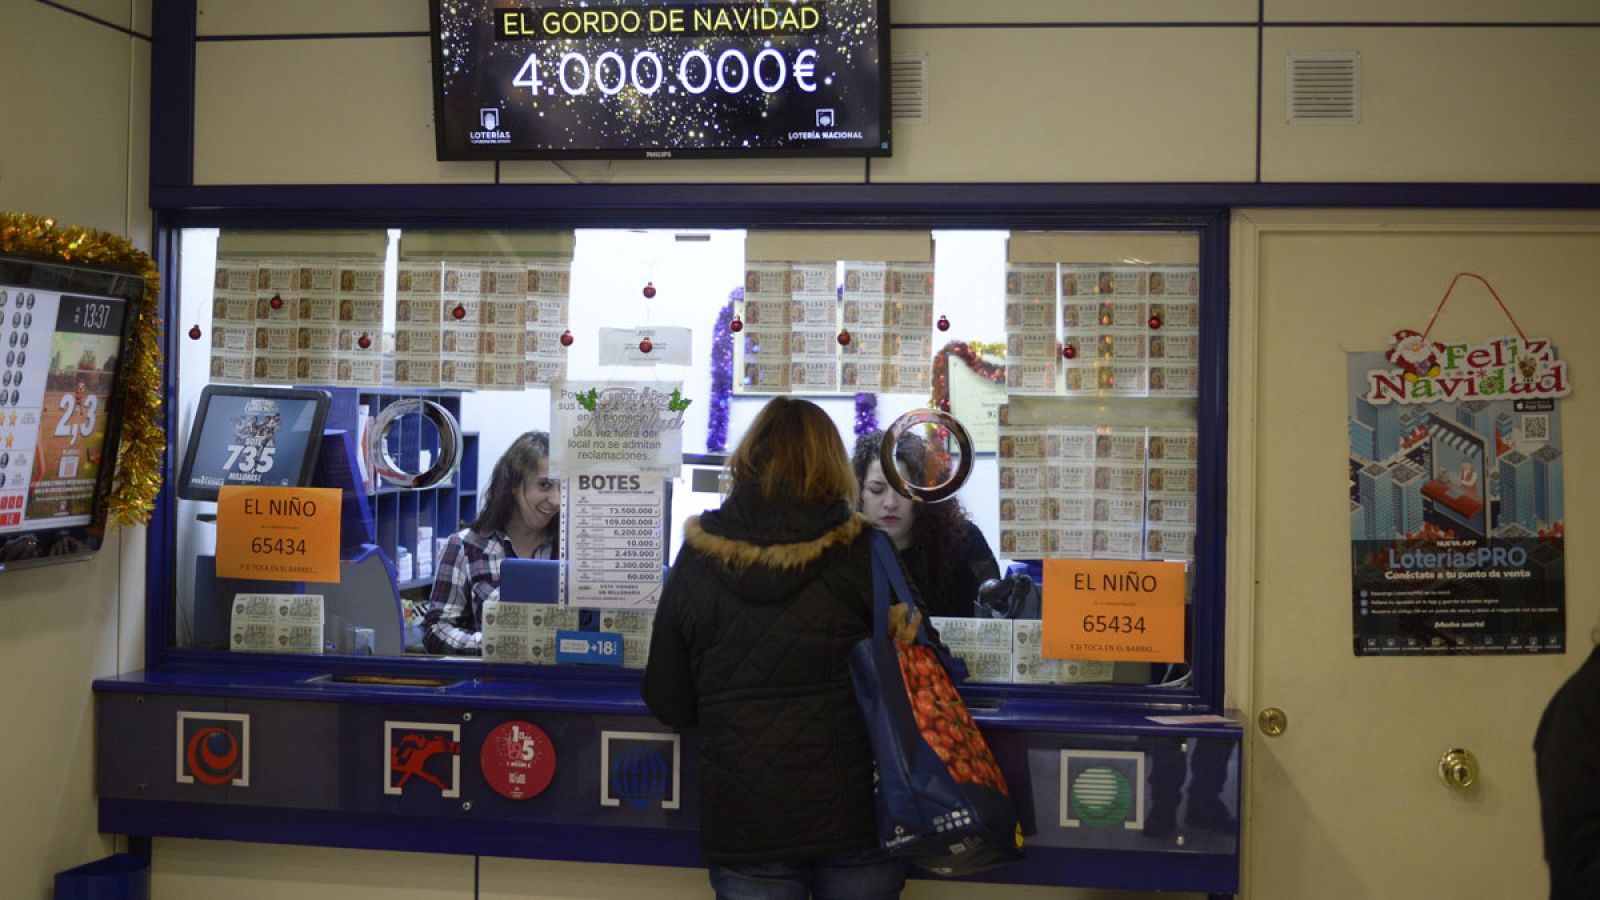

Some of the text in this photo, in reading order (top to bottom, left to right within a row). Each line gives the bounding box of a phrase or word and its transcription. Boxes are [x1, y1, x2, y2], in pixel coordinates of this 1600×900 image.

[503, 7, 819, 35] EL GORDO DE NAVIDAD
[512, 48, 817, 96] 4.000.000€
[822, 131, 864, 139] NACIONAL
[83, 303, 110, 329] 13:37
[1446, 337, 1548, 370] Feliz
[1371, 365, 1566, 400] Navidad
[54, 394, 98, 446] 2,3
[567, 439, 590, 449] local
[607, 441, 619, 449] se
[622, 440, 661, 450] admiten
[222, 445, 276, 473] 73,5
[577, 451, 651, 460] reclamaciones.
[578, 475, 641, 490] BOTES
[244, 496, 317, 517] EL NIÑO
[251, 536, 307, 555] 65434
[1074, 570, 1157, 592] EL NIÑO
[1384, 571, 1435, 579] Conéctate
[1459, 571, 1487, 579] punto
[1083, 615, 1146, 634] 65434
[1083, 643, 1103, 651] TOCA
[1104, 644, 1114, 652] EN
